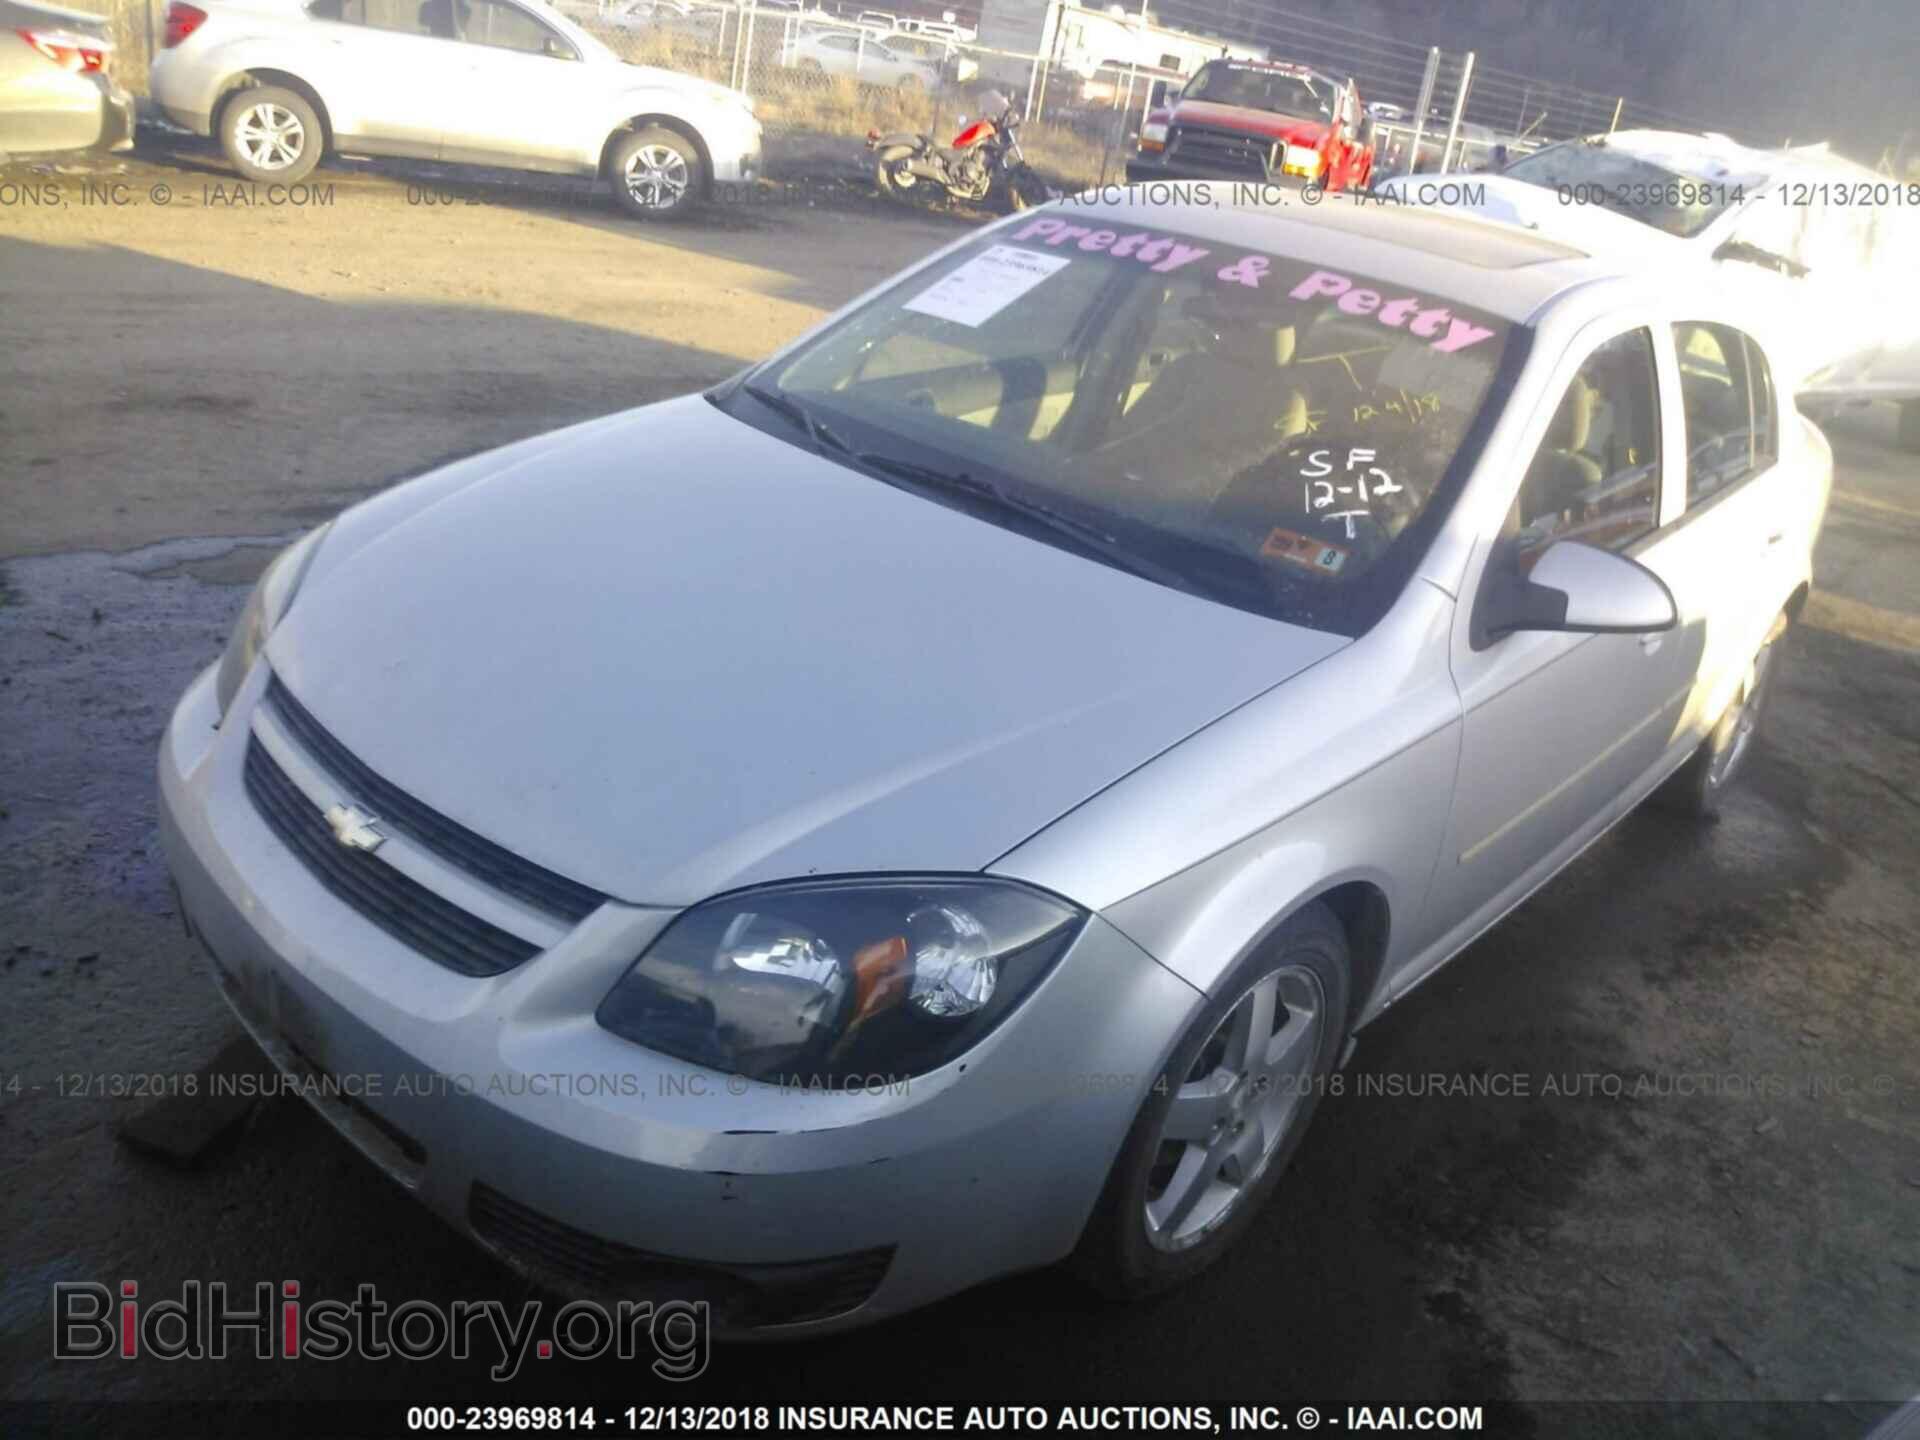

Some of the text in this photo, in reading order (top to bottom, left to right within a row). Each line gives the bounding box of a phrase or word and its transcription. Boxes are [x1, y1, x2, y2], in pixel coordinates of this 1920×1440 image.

[1013, 220, 1208, 272] Pretty
[1216, 256, 1271, 288] &
[1290, 271, 1495, 352] Petty
